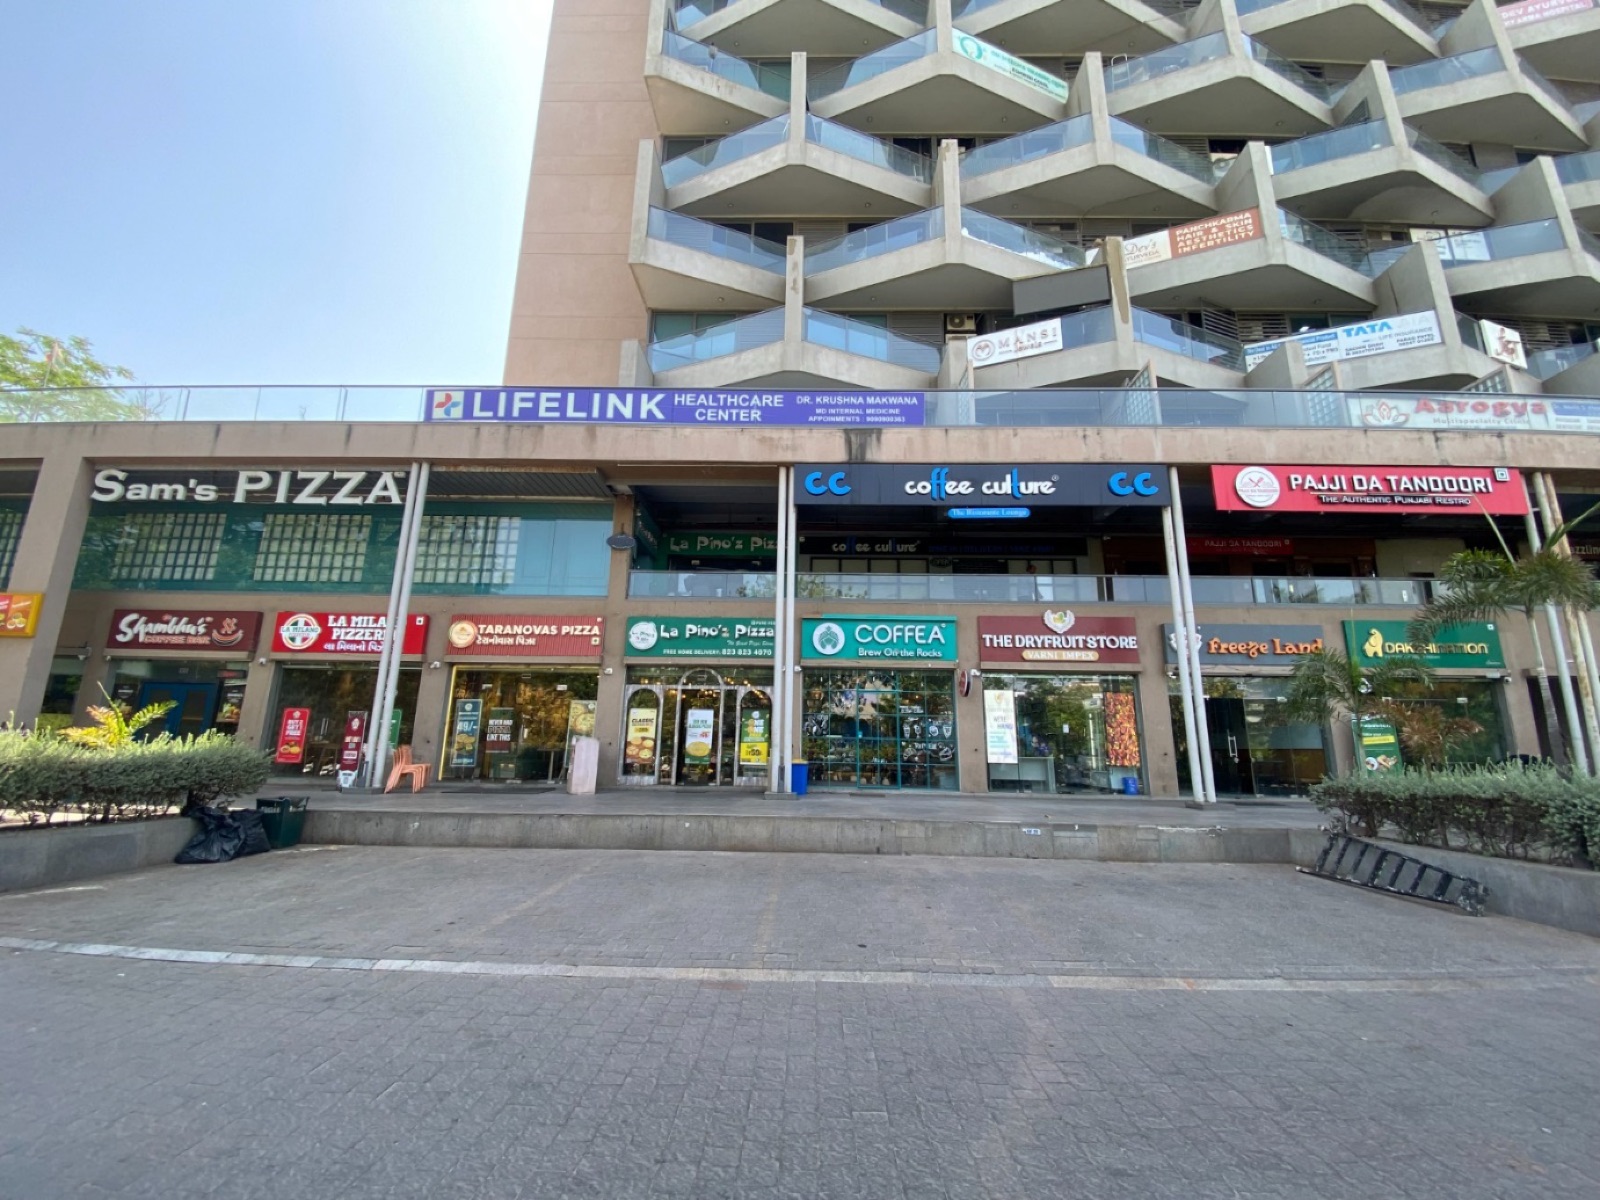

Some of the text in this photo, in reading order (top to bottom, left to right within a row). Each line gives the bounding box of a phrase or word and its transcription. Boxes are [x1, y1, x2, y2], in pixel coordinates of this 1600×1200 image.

[1176, 212, 1251, 234] PANCHKARMA
[1177, 230, 1203, 242] HAIR
[1225, 218, 1252, 229] SKIN
[1177, 225, 1253, 248] AESTHETICS
[1178, 231, 1254, 253] INFERTILITY
[998, 327, 1057, 349] MANSI
[1341, 320, 1392, 338] TATA
[473, 391, 666, 419] LIFELINK
[674, 393, 784, 407] HEALTHCARE
[796, 396, 918, 405] DR. KRUSHNA MAKWANA
[1414, 396, 1548, 418] Aarogya
[695, 408, 762, 421] CENTER
[91, 468, 403, 505] Sam's PIZZA
[904, 468, 1056, 501] coffee culture
[1289, 474, 1493, 493] PAJJI DA TANDOORI
[1320, 494, 1471, 505] THE AUTHENTIC PUNJABI RESTRO
[669, 538, 689, 552] La
[697, 536, 743, 552] Pino'z
[832, 536, 918, 554] coffee culture
[115, 612, 209, 644] Shambhu's
[327, 615, 347, 627] LA
[478, 624, 600, 635] TARANOVAS PIZZA
[144, 635, 211, 645] COFFEE BAR
[660, 624, 775, 639] La Pino'z Pizza
[855, 624, 945, 644] COFFEA
[982, 634, 1013, 648] THE
[1272, 638, 1323, 655] Land
[859, 648, 881, 656] Brew
[899, 648, 914, 657] the
[917, 648, 943, 657] Rocks
[1027, 650, 1095, 660] VARNI IMPEX
